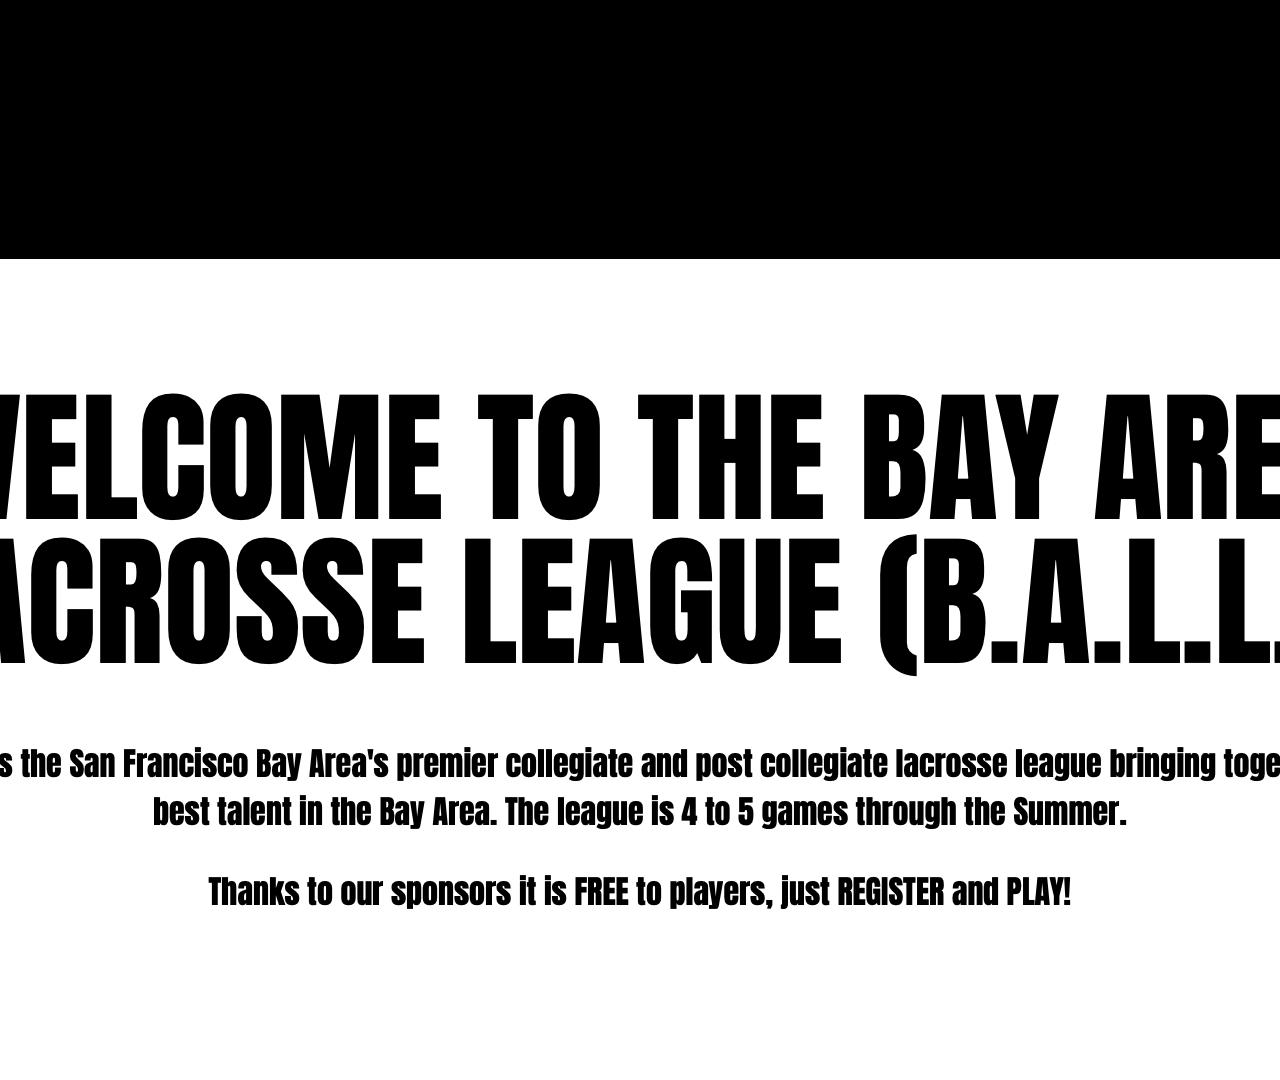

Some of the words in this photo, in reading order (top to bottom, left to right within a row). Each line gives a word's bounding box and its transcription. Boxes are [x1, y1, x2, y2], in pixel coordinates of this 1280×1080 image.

[478, 394, 600, 520] TO
[638, 395, 823, 519] THE
[864, 395, 1059, 519] BAY
[465, 538, 841, 664] LEAGUE
[21, 749, 61, 777] the
[70, 749, 115, 777] San
[124, 747, 248, 777] Francisco
[257, 749, 301, 781] Bay
[309, 749, 388, 777] Area's
[397, 747, 498, 781] premier
[506, 747, 632, 781] collegiate
[641, 749, 687, 777] and
[696, 749, 752, 781] post
[761, 747, 887, 781] collegiate
[896, 749, 1007, 777] lacrosse
[1016, 749, 1101, 781] league
[1111, 747, 1215, 781] bringing
[154, 797, 209, 825] best
[217, 797, 291, 825] talent
[300, 795, 322, 825] in
[331, 797, 371, 825] the
[381, 797, 424, 829] Bay
[433, 797, 497, 825] Area.
[505, 797, 548, 825] The
[558, 797, 643, 829] league
[652, 795, 674, 825] is
[682, 797, 697, 825] 4
[705, 797, 730, 825] to
[739, 797, 753, 825] 5
[762, 801, 848, 829] games
[856, 797, 956, 829] through
[964, 797, 1005, 825] the
[1014, 797, 1126, 825] Summer.
[209, 877, 299, 905] Thanks
[307, 877, 332, 905] to
[341, 881, 383, 905] our
[391, 881, 511, 909] sponsors
[520, 875, 536, 905] it
[545, 875, 566, 905] is
[576, 877, 628, 905] FREE
[636, 877, 661, 905] to
[670, 877, 772, 909] players,
[781, 875, 829, 909] just
[839, 877, 944, 905] REGISTER
[952, 877, 998, 905] and
[1008, 877, 1070, 905] PLAY!
